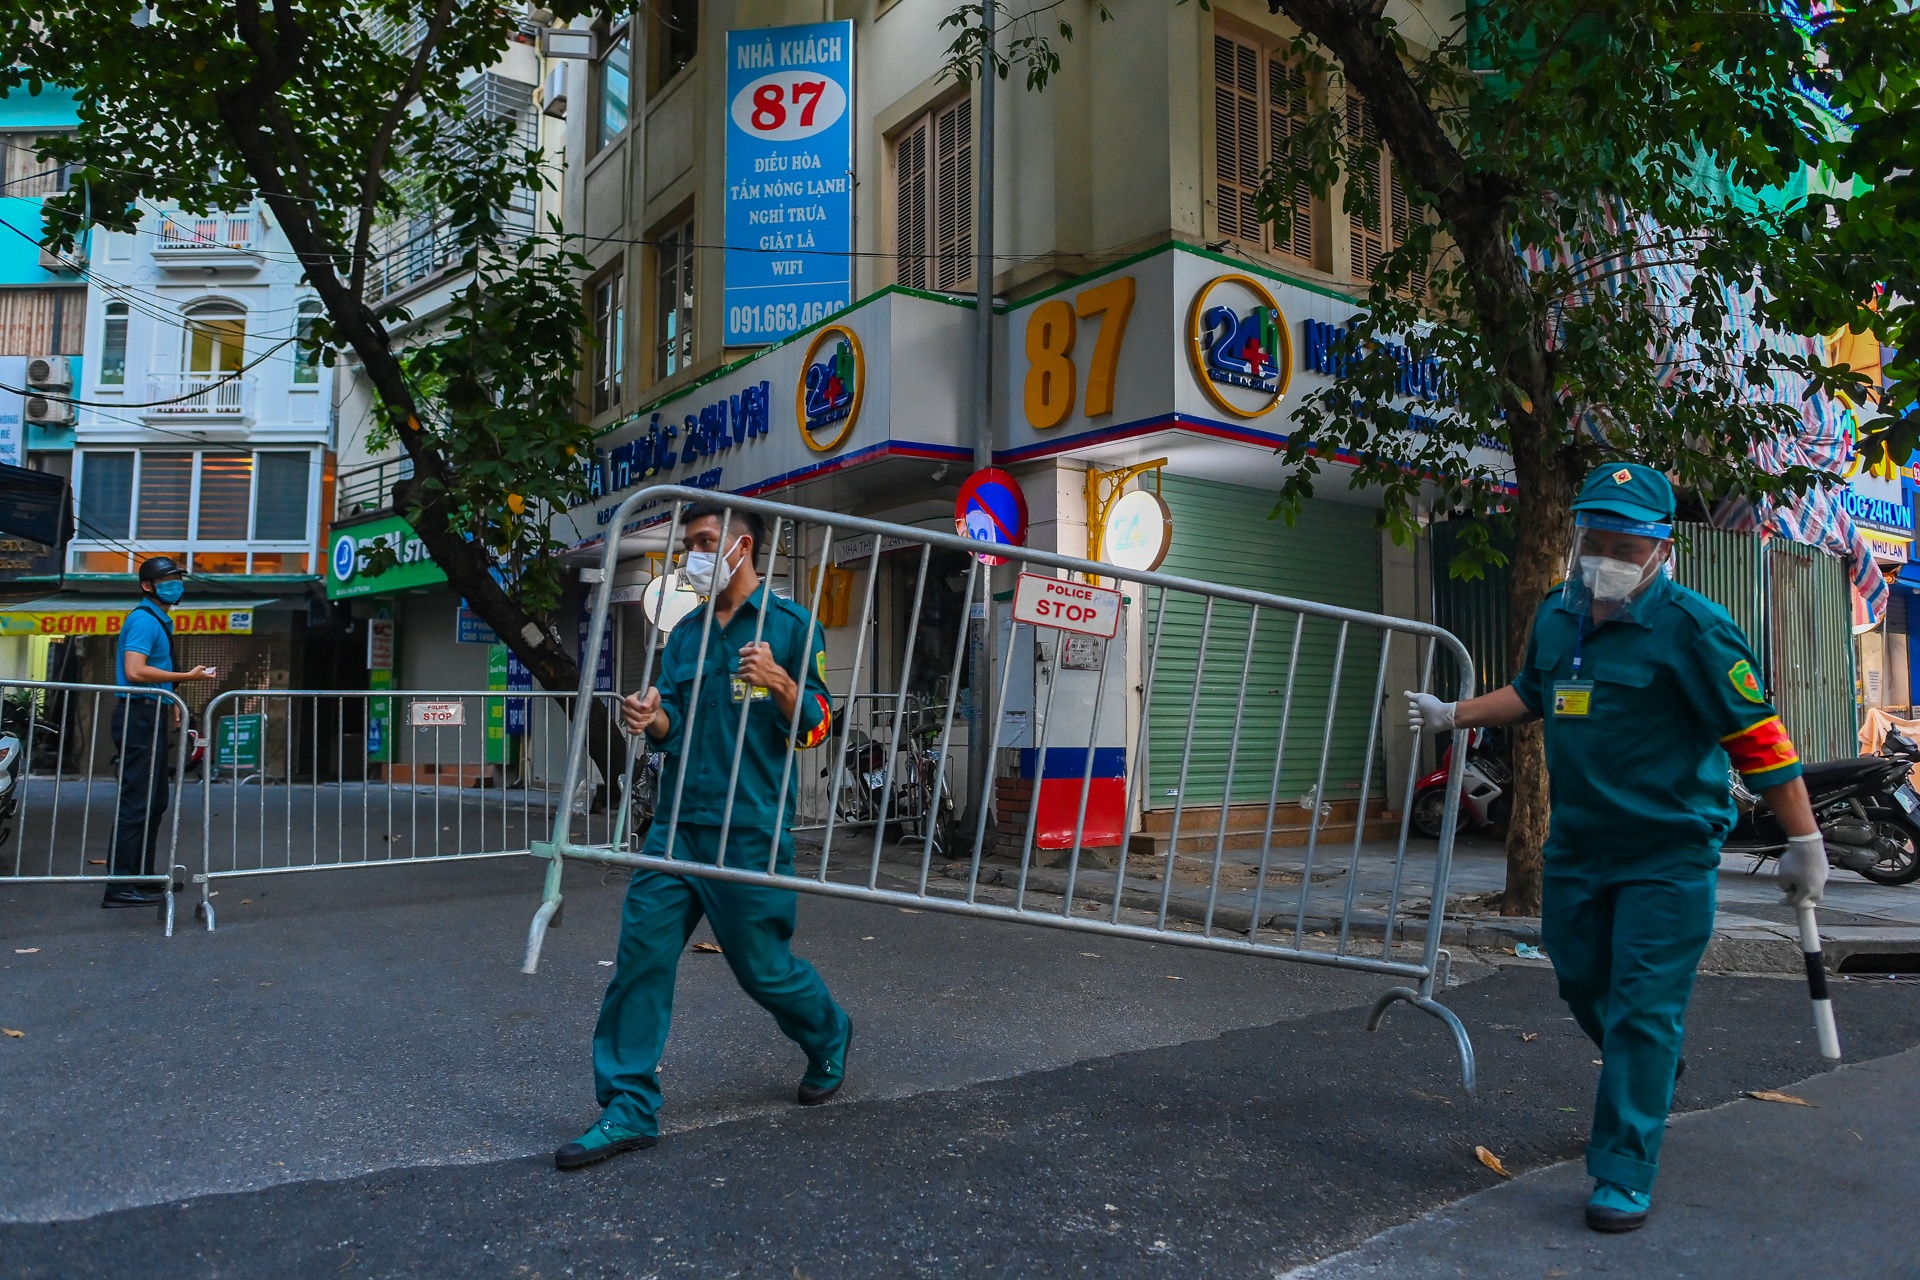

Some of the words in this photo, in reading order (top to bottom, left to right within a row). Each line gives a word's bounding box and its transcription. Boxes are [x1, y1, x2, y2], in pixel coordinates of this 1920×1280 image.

[737, 42, 774, 69] NHÀ
[780, 34, 841, 67] KHÁCH
[751, 81, 826, 131] 87
[754, 151, 788, 173] ĐIỀU
[792, 151, 821, 169] HÒA
[730, 179, 760, 200] TẮM
[764, 180, 803, 197] NÓNG
[807, 178, 846, 200] LẠNH
[749, 211, 785, 225] NGHỈ
[789, 208, 826, 222] TRƯA
[797, 229, 816, 248] LÀ
[772, 260, 804, 276] WIFI
[1024, 276, 1136, 429] 87
[1868, 496, 1912, 529] 24H.VN
[1046, 583, 1092, 601] POLICE
[1036, 599, 1097, 623] STOP
[41, 615, 97, 633] CƠM
[175, 612, 228, 632] DÂN
[423, 712, 452, 721] STOP
